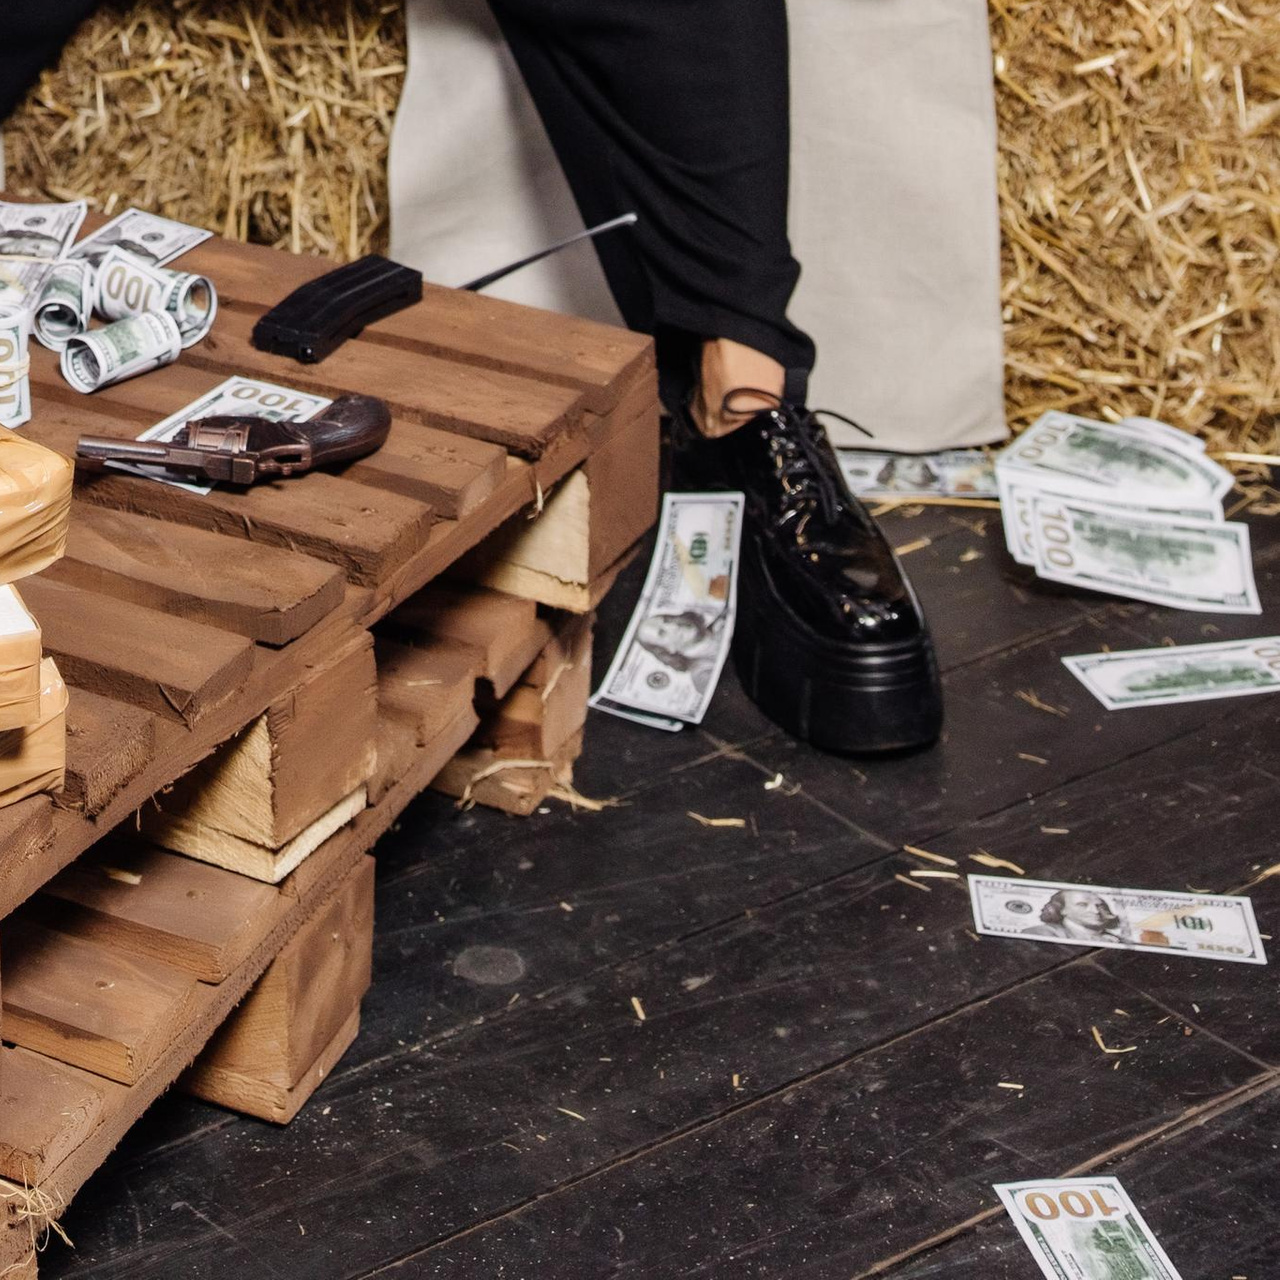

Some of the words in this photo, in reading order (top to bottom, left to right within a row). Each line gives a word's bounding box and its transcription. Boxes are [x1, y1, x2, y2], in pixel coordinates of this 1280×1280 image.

[106, 266, 154, 313] 100
[232, 387, 302, 411] 100
[1042, 505, 1074, 568] 100
[1025, 1189, 1120, 1220] 100
